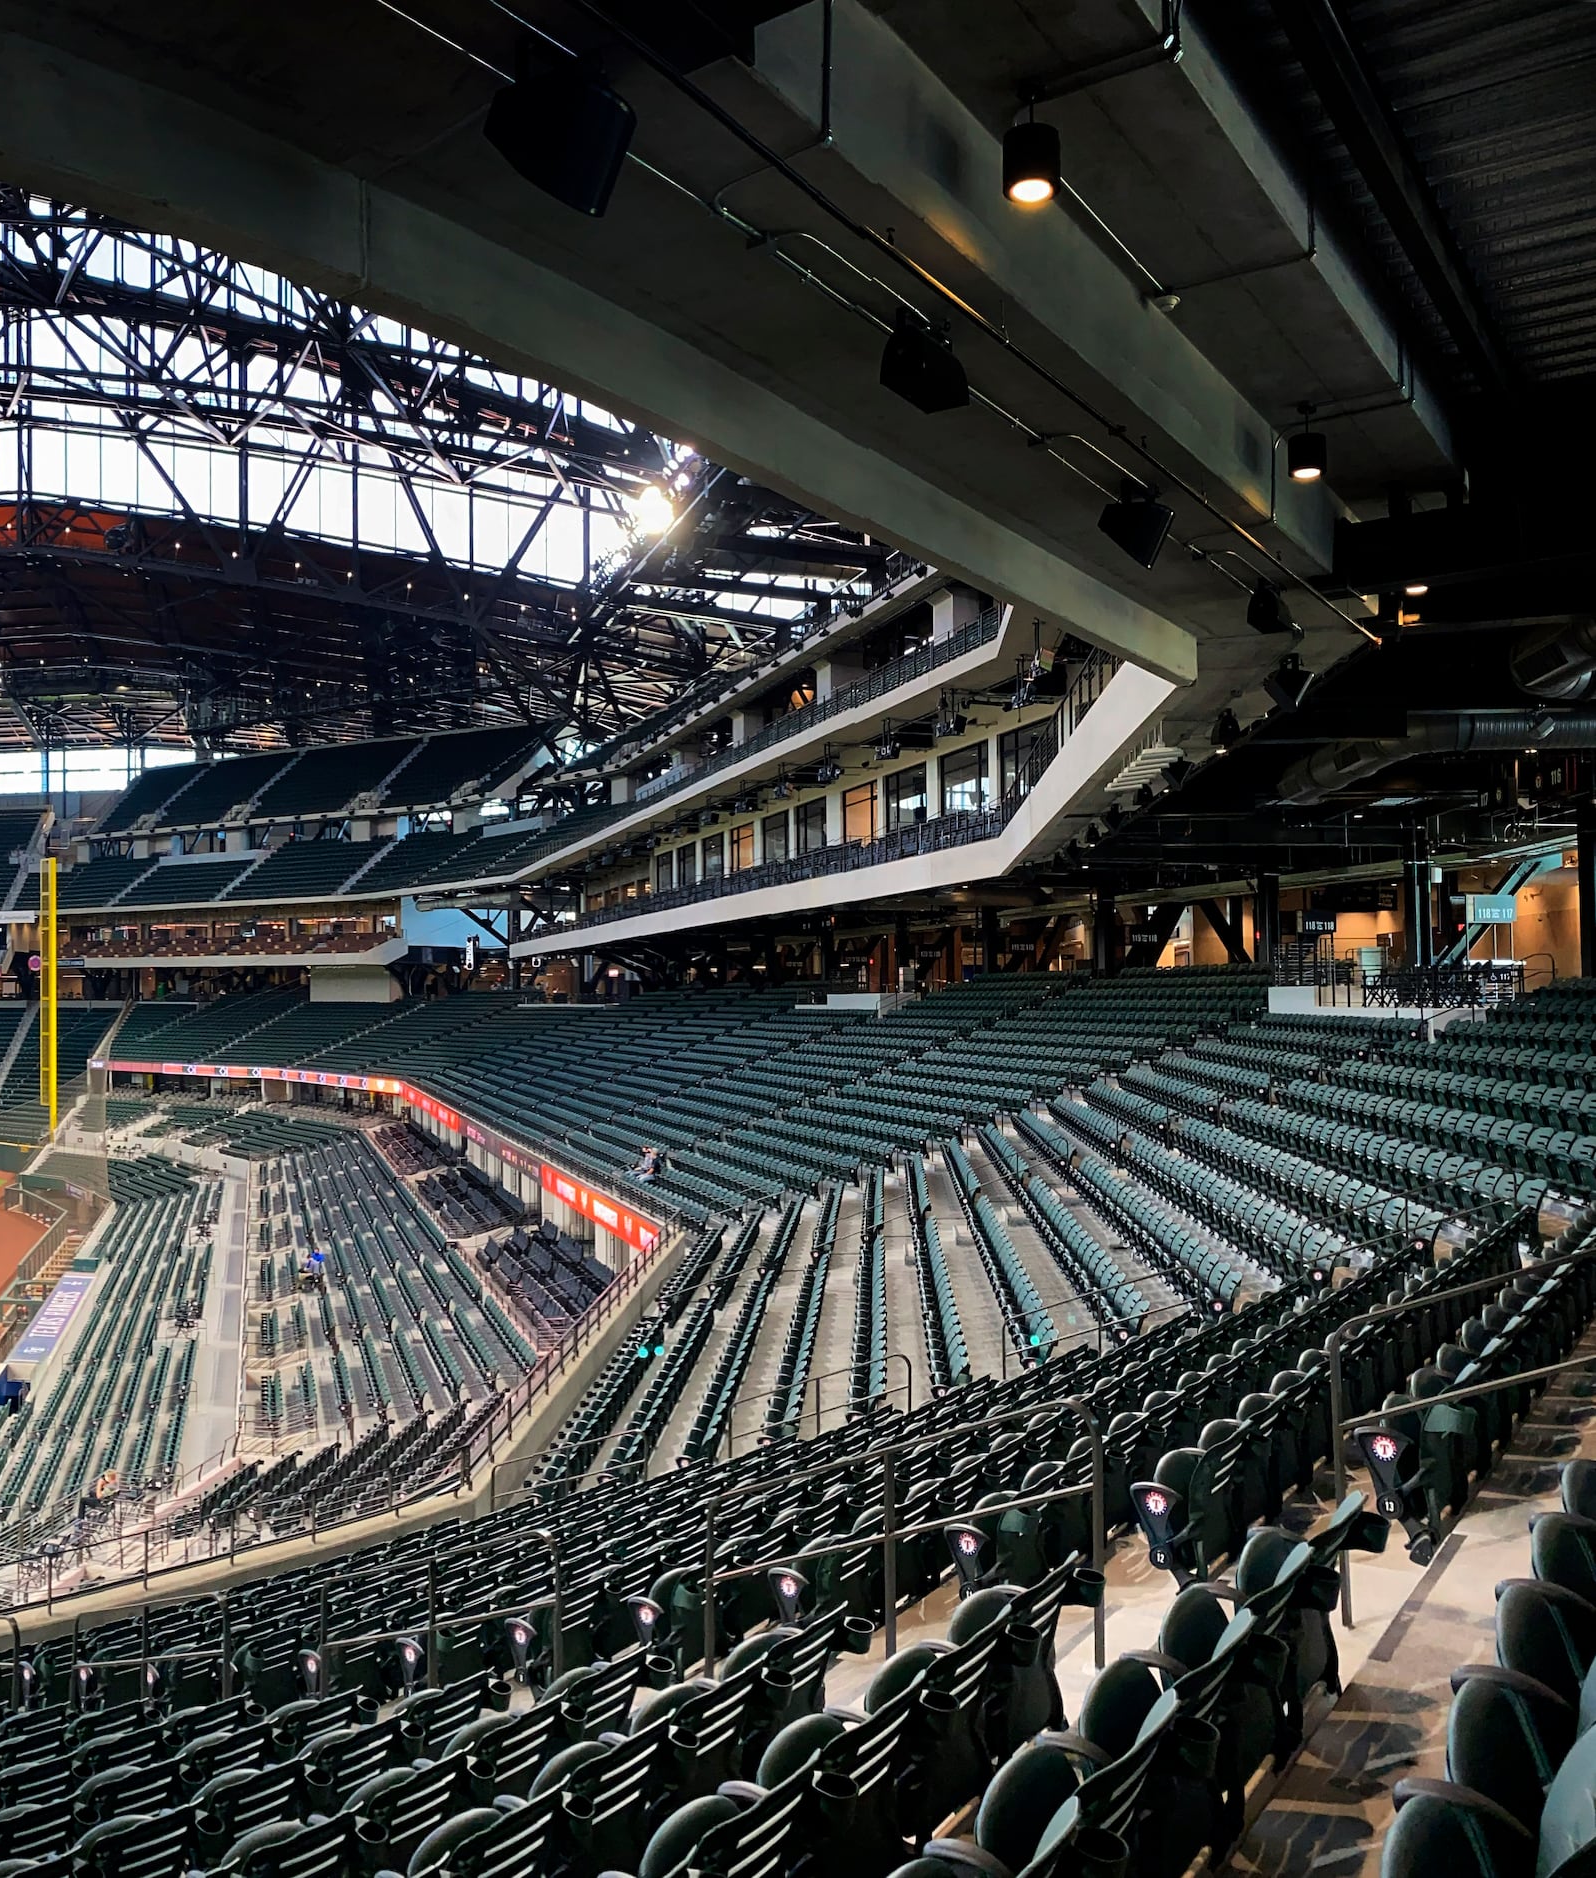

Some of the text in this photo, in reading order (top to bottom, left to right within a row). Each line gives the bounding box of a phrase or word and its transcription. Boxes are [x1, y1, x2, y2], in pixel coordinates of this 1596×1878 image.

[1478, 907, 1513, 919] 118 117
[1305, 921, 1335, 931] 118 118
[28, 1290, 81, 1338] TEXAS RANGERS
[1385, 1500, 1394, 1512] 13
[1157, 1551, 1165, 1564] 12
